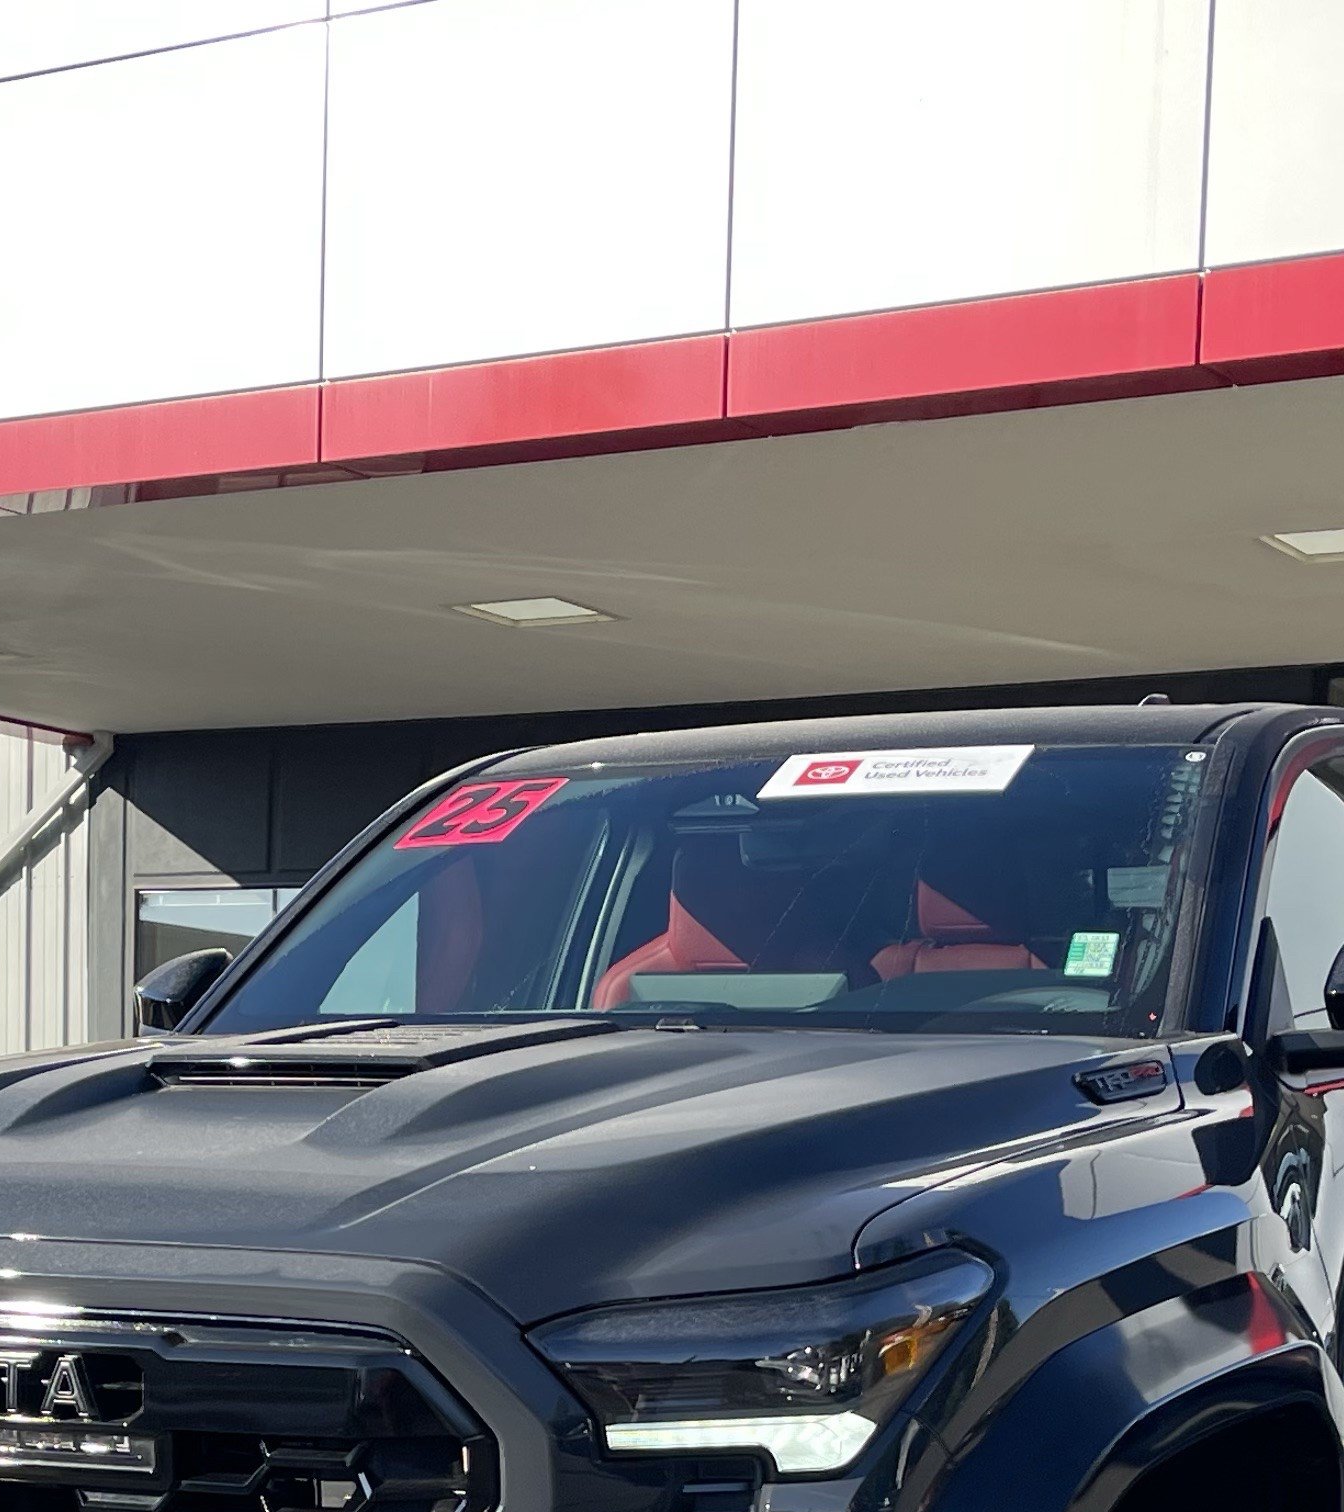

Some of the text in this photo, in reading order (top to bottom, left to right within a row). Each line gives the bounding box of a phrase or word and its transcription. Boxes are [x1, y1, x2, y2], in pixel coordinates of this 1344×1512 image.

[872, 758, 952, 770] Certified
[864, 768, 987, 780] Used Vehicles
[409, 781, 558, 840] 25
